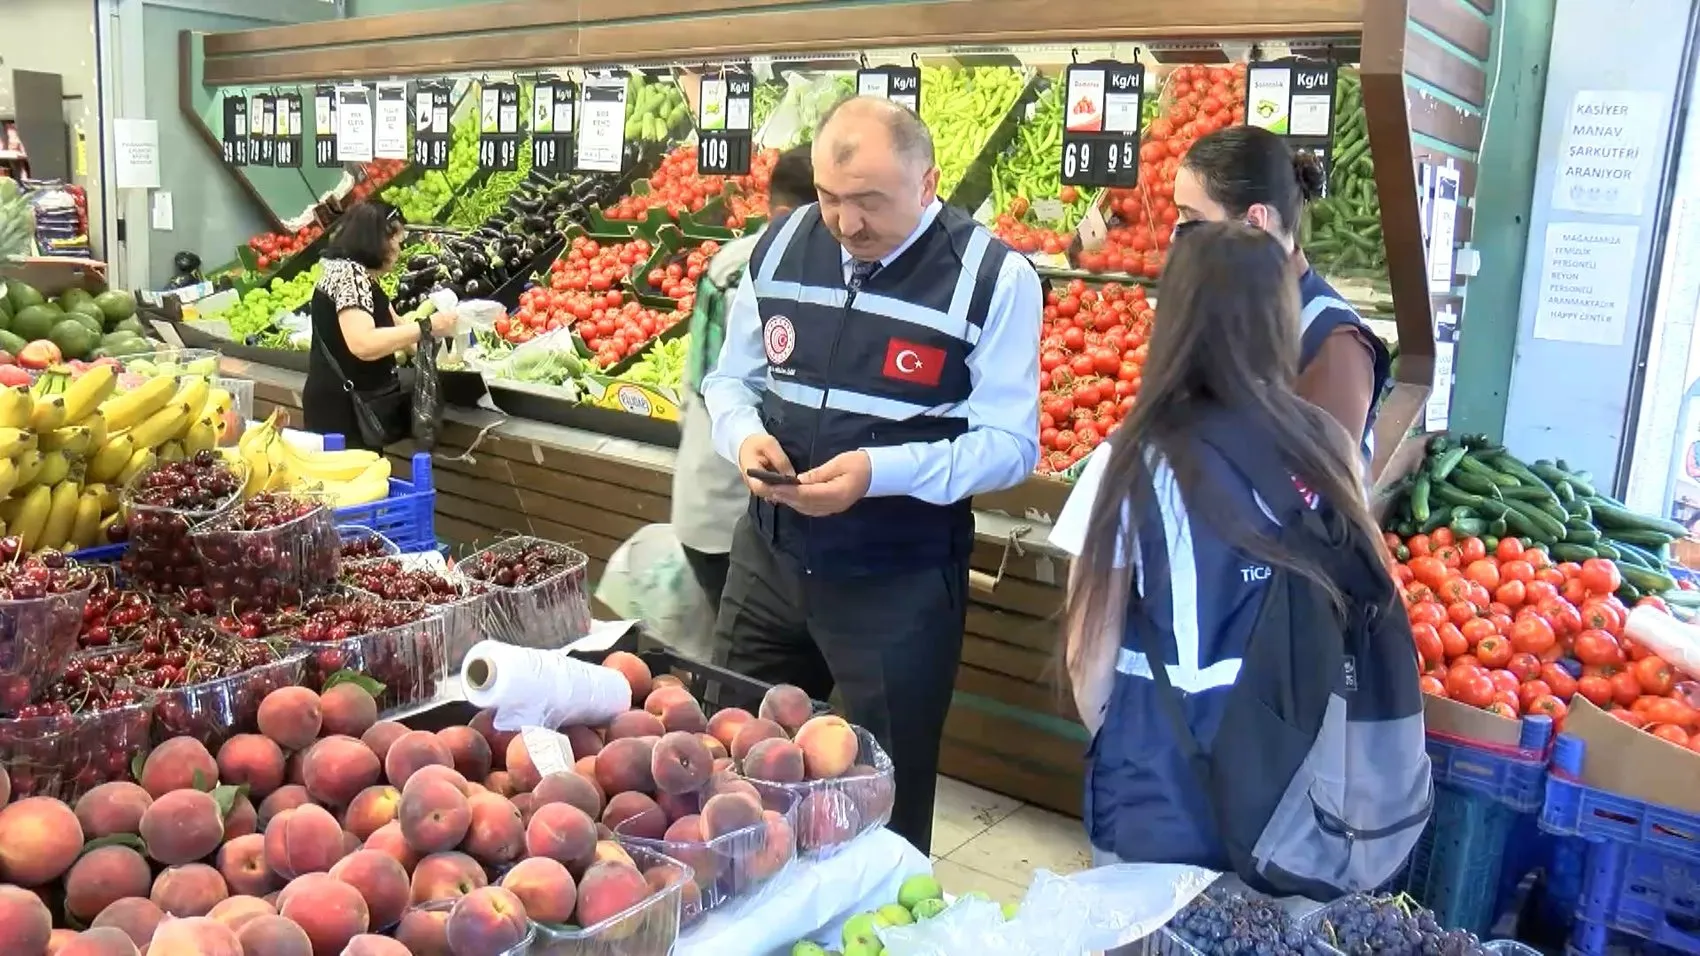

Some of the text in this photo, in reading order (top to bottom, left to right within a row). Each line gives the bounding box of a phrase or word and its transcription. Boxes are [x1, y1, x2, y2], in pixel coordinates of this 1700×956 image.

[730, 82, 750, 95] Kg/tl
[893, 76, 916, 91] Kg/tl
[1112, 74, 1139, 89] Kg/tl
[1297, 73, 1328, 89] Kg/tl
[1576, 101, 1629, 116] KASİYER
[1572, 125, 1623, 137] MANAV
[278, 141, 291, 163] 109
[416, 139, 446, 165] 39 95
[481, 140, 515, 167] 49 95
[535, 140, 556, 167] 109
[701, 138, 728, 169] 109
[1064, 141, 1133, 178] 69 95
[1565, 166, 1632, 180] ARANIYOR
